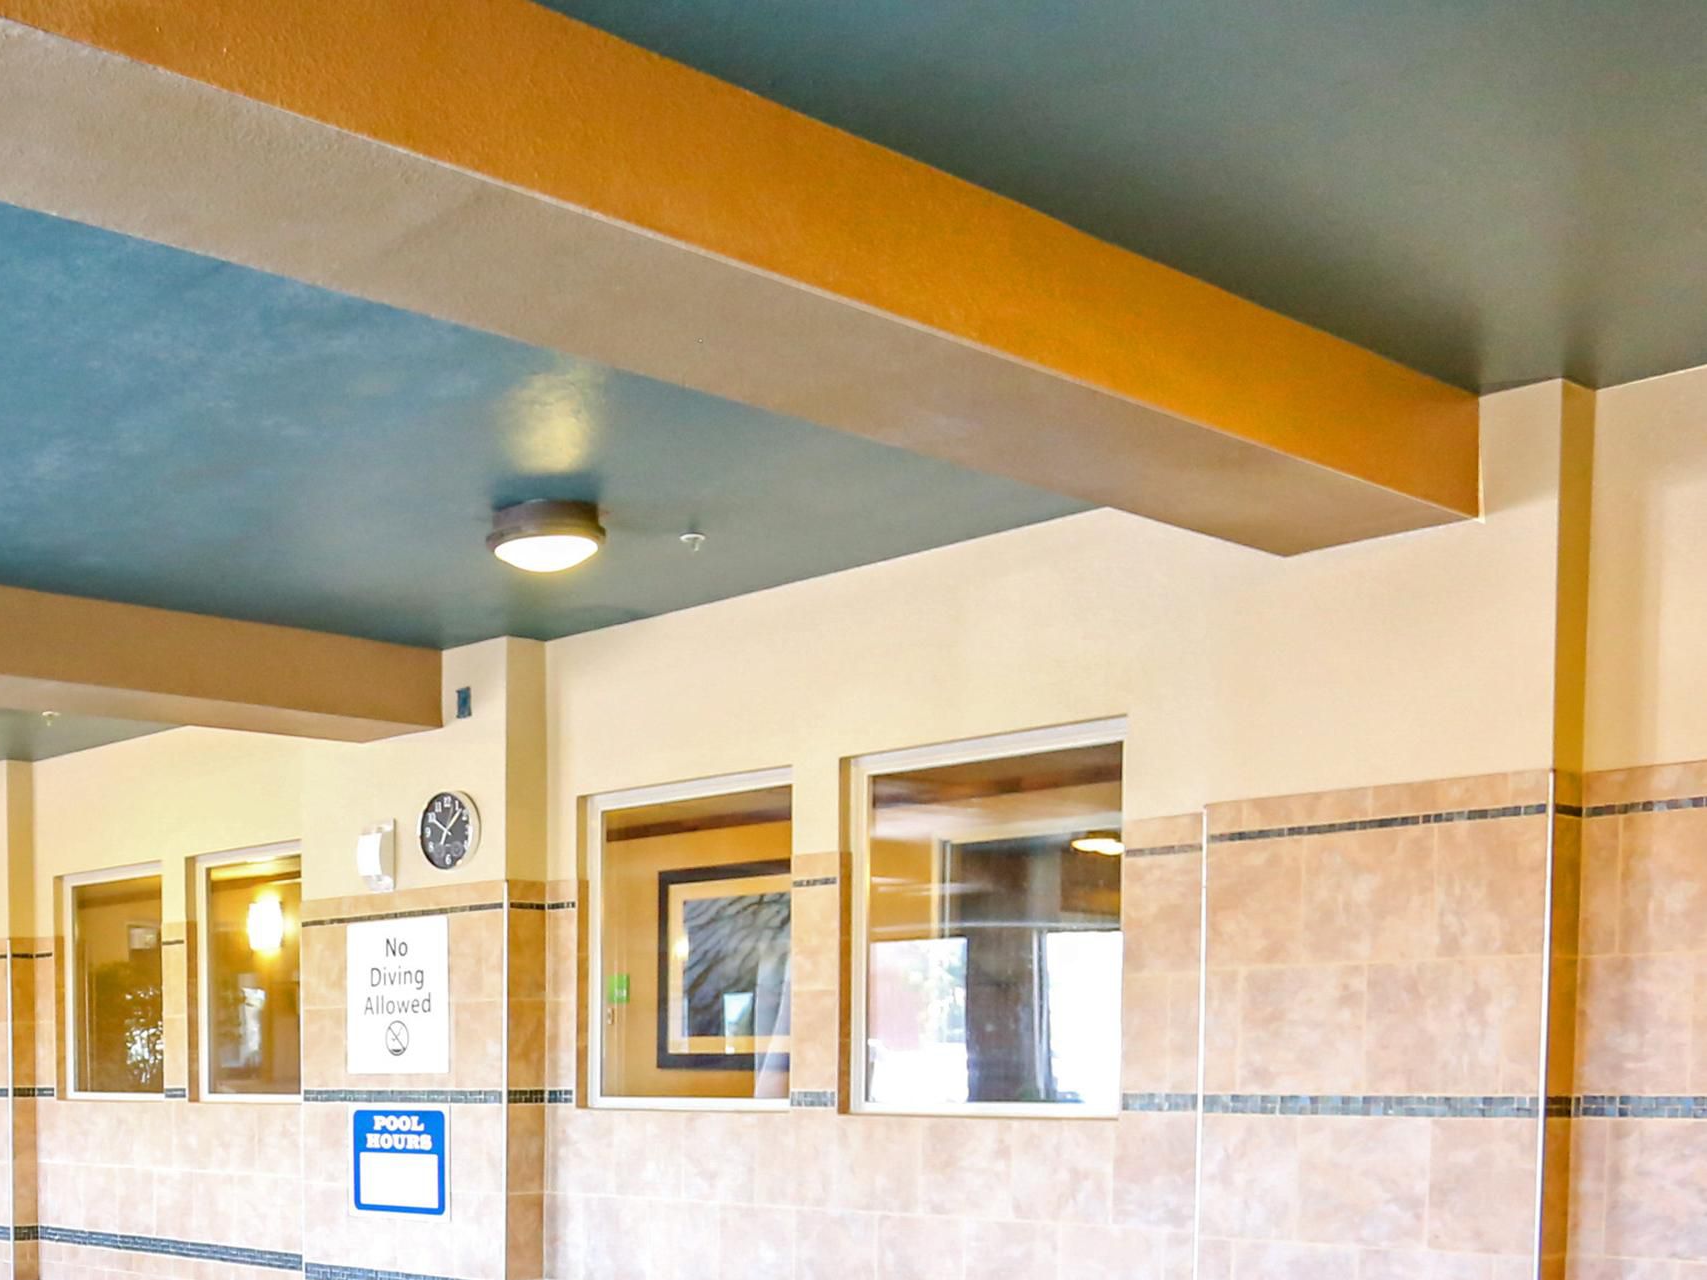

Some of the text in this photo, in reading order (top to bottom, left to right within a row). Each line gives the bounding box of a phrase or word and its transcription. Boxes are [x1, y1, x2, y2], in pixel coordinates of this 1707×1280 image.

[385, 937, 408, 957] No
[370, 965, 424, 990] Diving
[364, 992, 432, 1015] Allowed
[373, 1115, 425, 1131] POOL
[365, 1133, 433, 1150] HOURS
